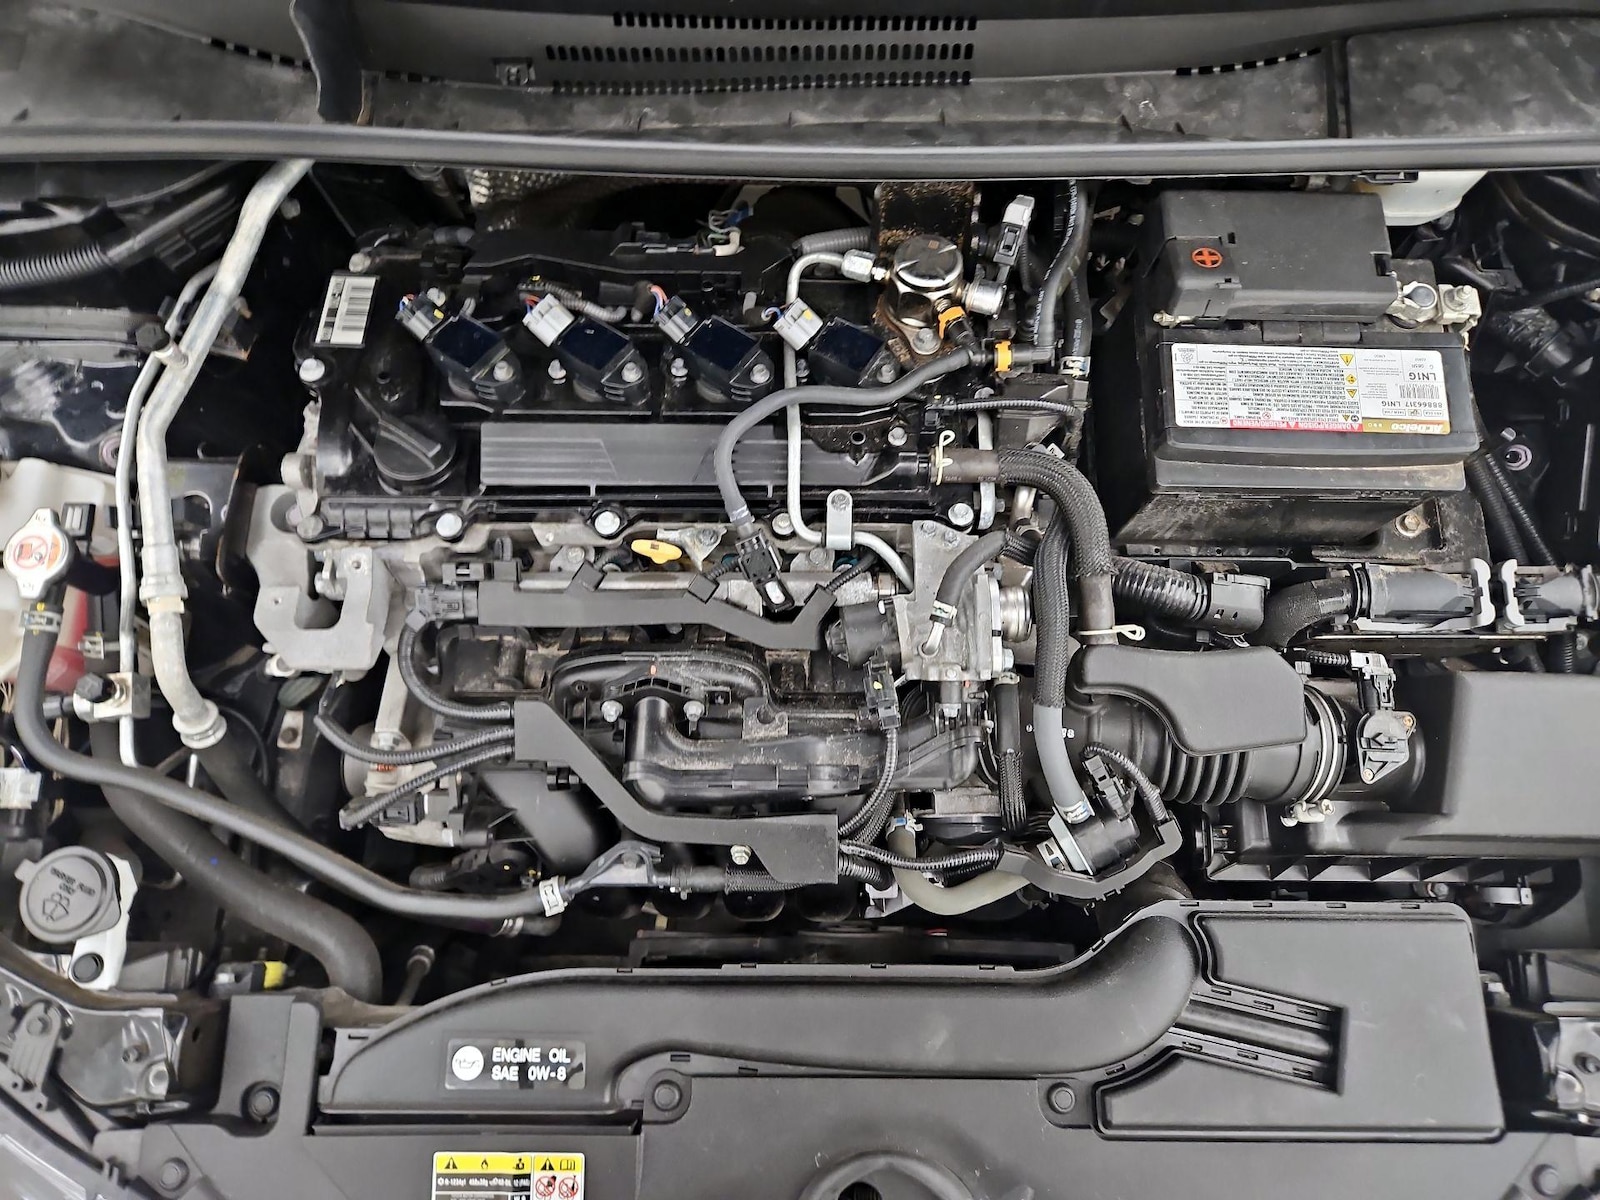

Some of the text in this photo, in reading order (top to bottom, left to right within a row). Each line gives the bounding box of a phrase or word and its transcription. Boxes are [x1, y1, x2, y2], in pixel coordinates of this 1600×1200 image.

[1408, 372, 1436, 381] LN1G
[492, 1047, 571, 1064] ENGINE OIL
[491, 1065, 566, 1081] SAE 0W-8
